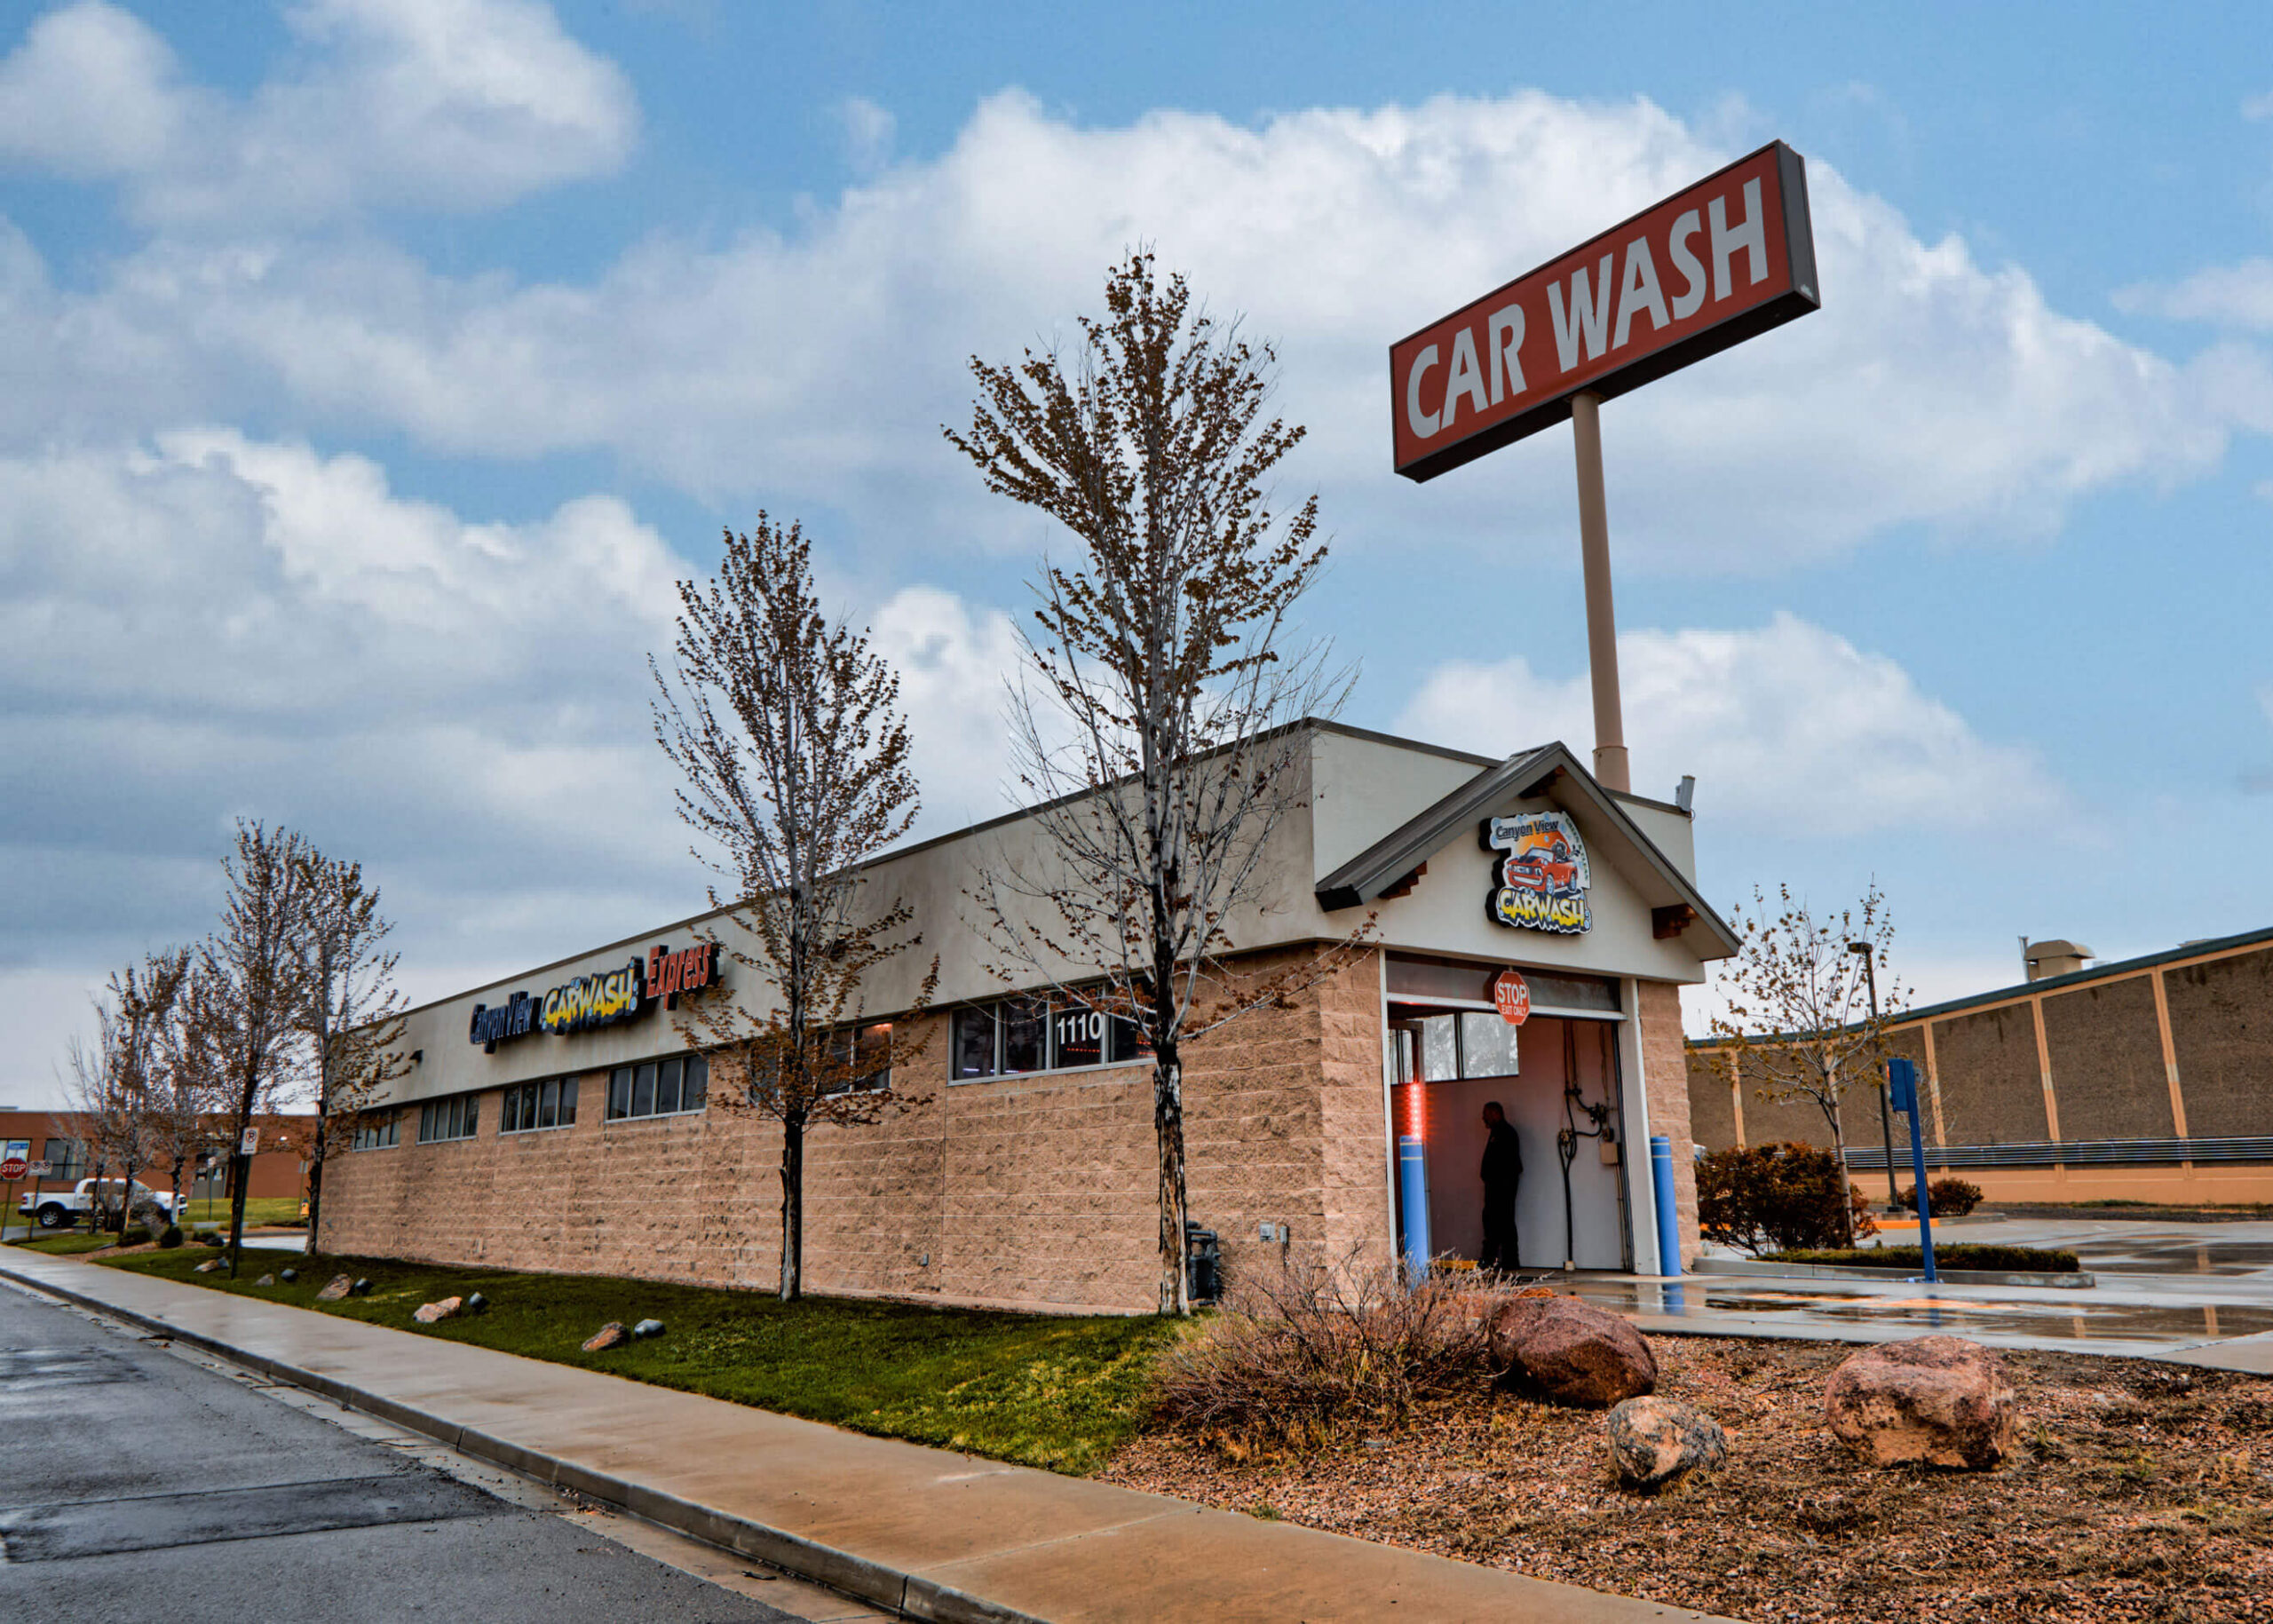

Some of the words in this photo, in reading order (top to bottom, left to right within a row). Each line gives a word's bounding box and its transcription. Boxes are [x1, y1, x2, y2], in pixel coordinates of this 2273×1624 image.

[1407, 304, 1527, 439] CAR
[1547, 177, 1769, 374] WASH
[1496, 825, 1532, 842] Canyon
[1534, 820, 1558, 834] View
[1499, 889, 1585, 927] CARWASH
[470, 1004, 506, 1054] Canyon
[506, 991, 534, 1036] View
[544, 967, 635, 1027] CARWASH
[645, 943, 711, 1011] Express
[1498, 982, 1527, 1005] STOP
[1501, 1005, 1512, 1015] EXIT
[1513, 1005, 1526, 1017] ONLY
[1057, 1010, 1103, 1045] 1110
[3, 1163, 26, 1173] STOP
